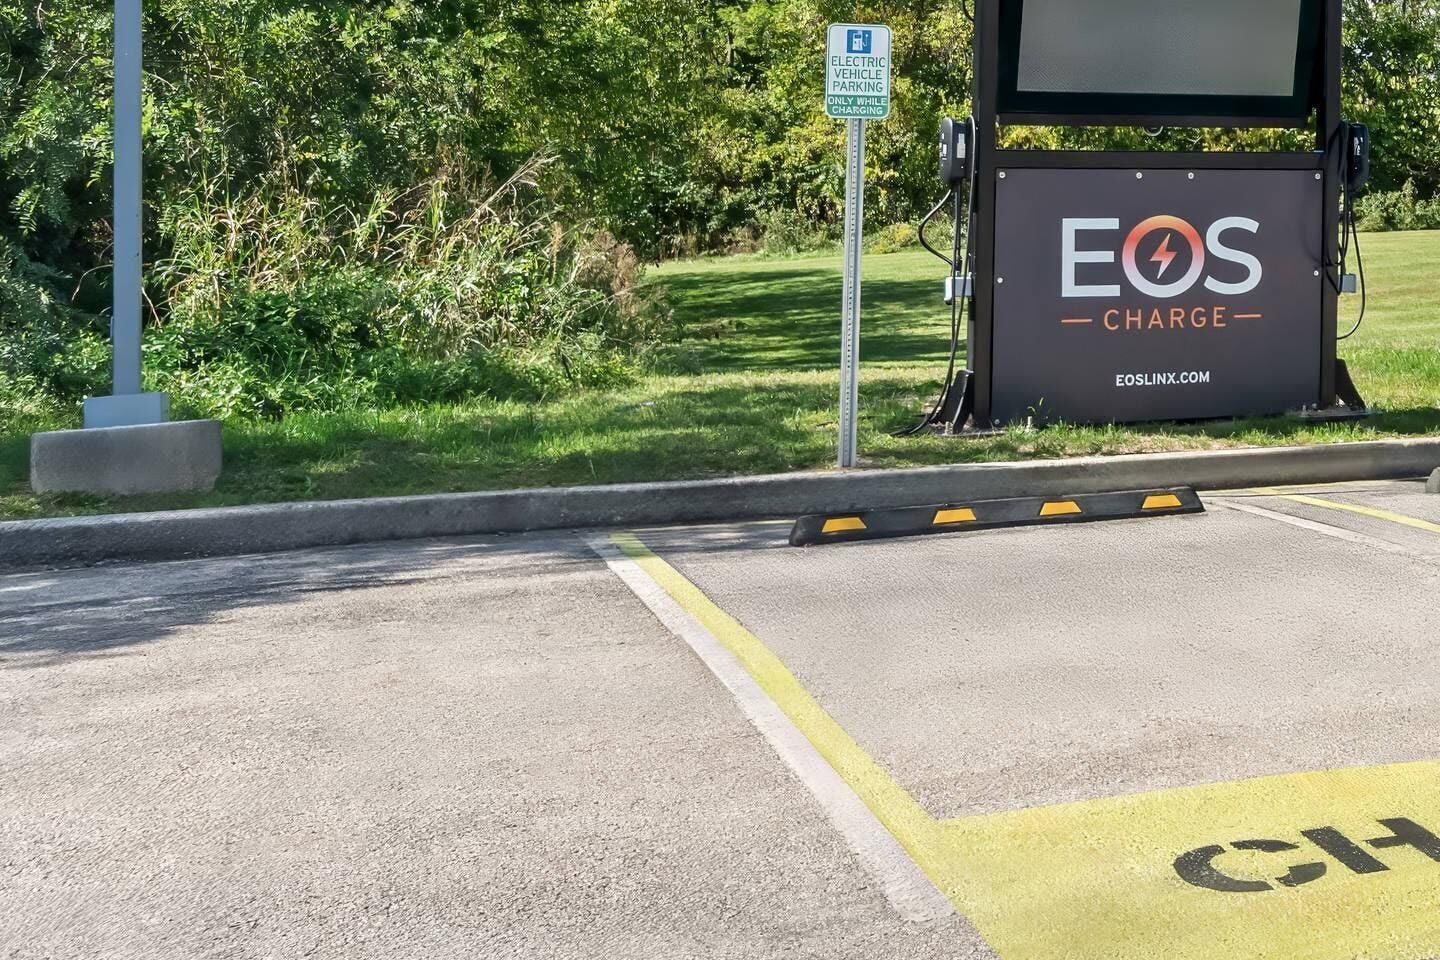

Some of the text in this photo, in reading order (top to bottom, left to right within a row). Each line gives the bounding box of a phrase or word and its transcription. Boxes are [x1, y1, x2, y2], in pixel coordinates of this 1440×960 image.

[831, 55, 886, 68] ELECTRIC
[834, 68, 883, 80] VEHICLE
[832, 80, 883, 93] PARKING
[827, 96, 888, 106] ONLY WHILE
[831, 105, 883, 115] CHARGING
[1061, 214, 1263, 299] EOS
[1103, 306, 1228, 331] CHARGE
[1115, 370, 1211, 387] EOSLINX.COM
